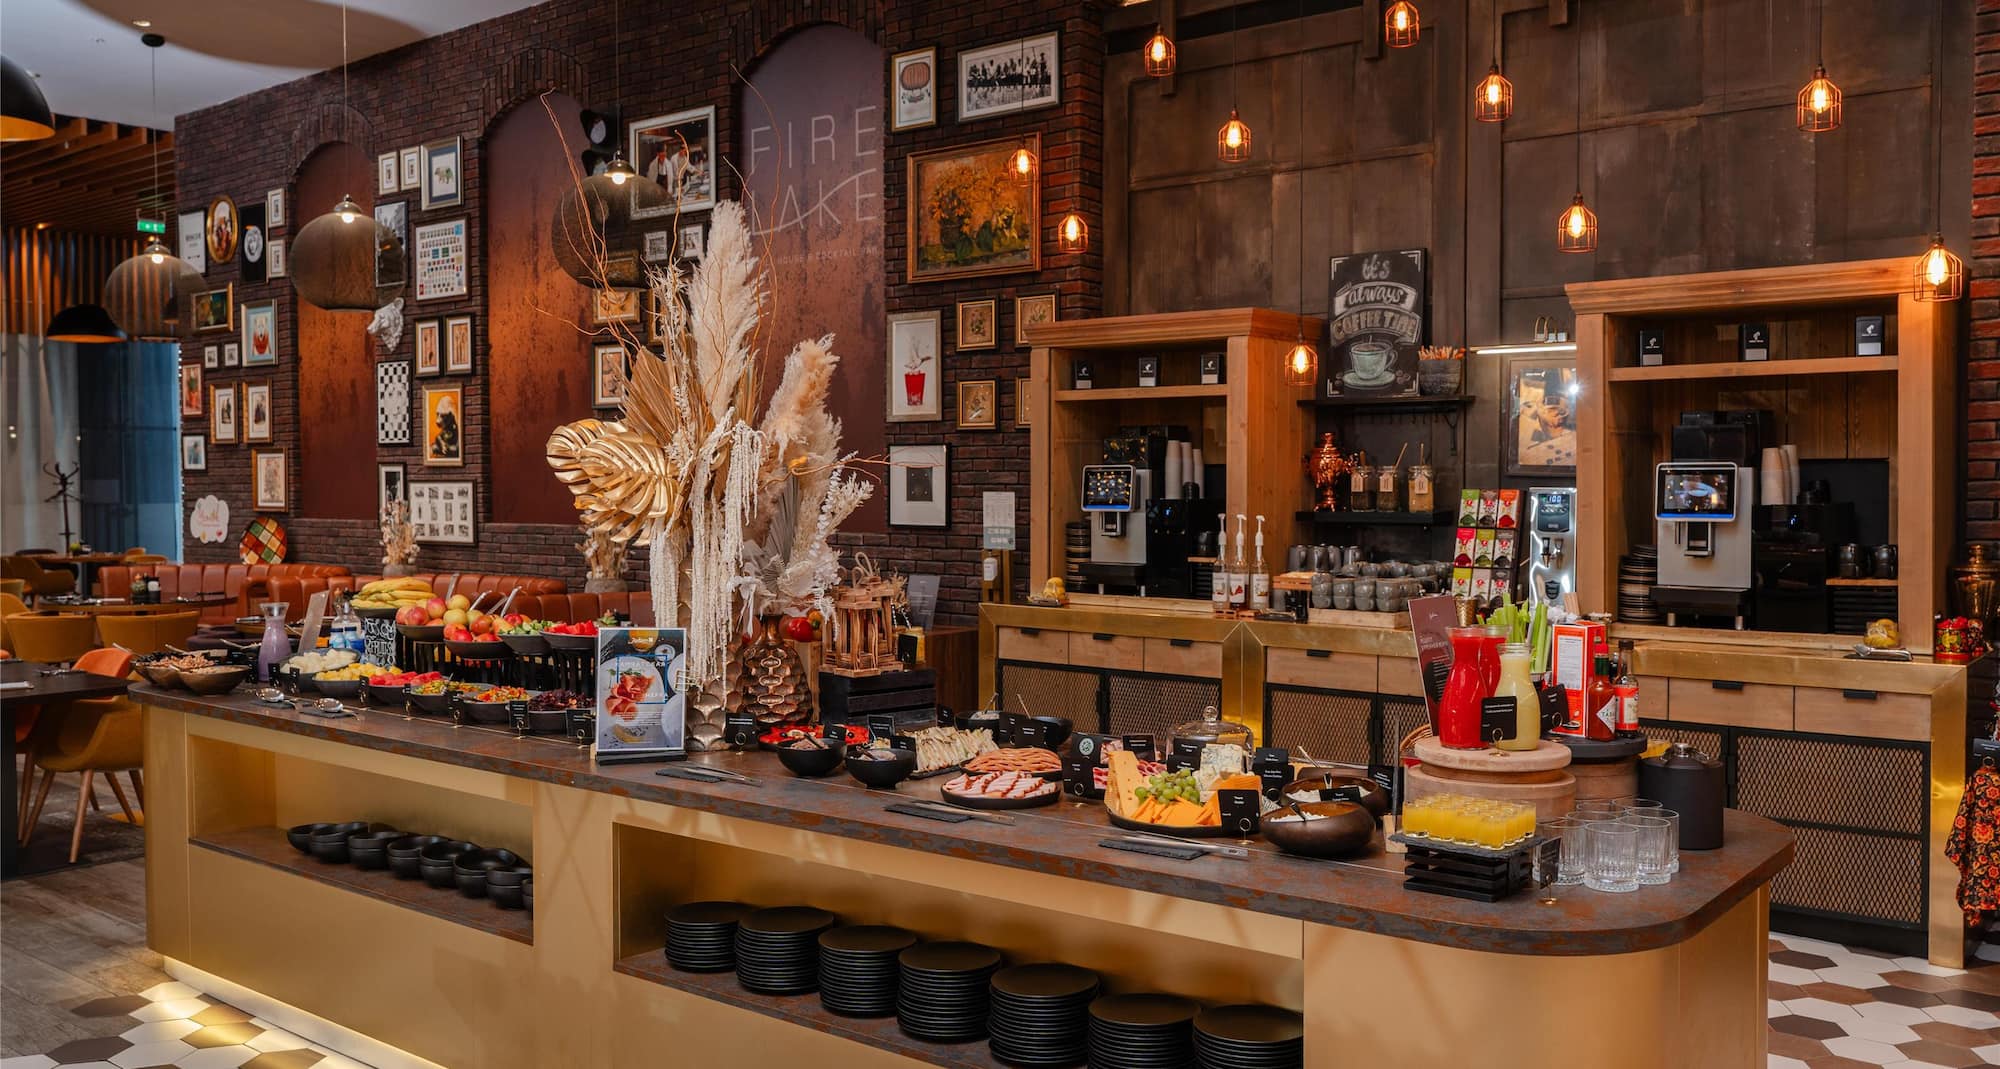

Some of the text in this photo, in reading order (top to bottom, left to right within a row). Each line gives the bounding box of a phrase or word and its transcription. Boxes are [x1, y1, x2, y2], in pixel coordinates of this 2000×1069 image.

[751, 105, 877, 174] FIRE
[751, 167, 877, 236] LAKE
[1362, 254, 1390, 280] it's
[1348, 285, 1404, 305] always
[1333, 310, 1417, 340] COFFEE TIME
[1549, 495, 1562, 503] 100
